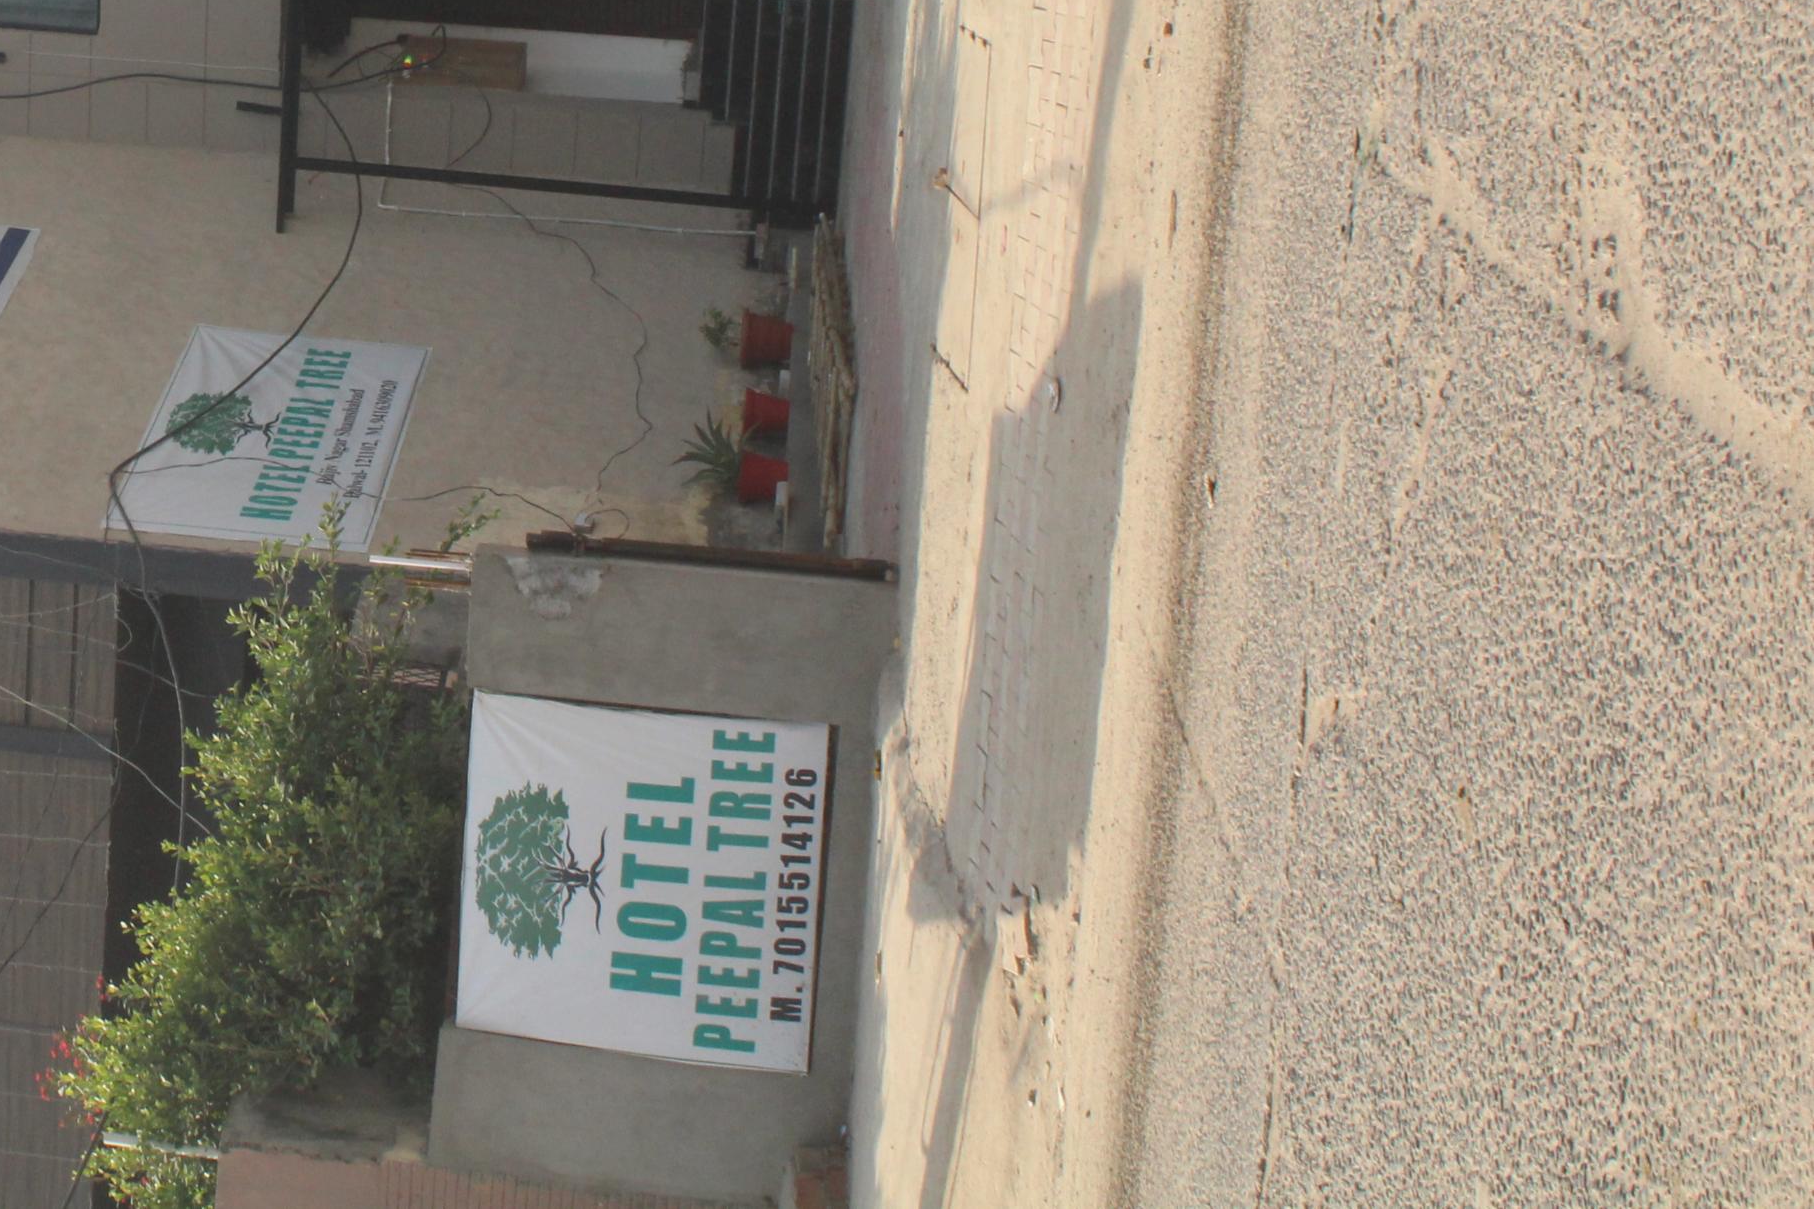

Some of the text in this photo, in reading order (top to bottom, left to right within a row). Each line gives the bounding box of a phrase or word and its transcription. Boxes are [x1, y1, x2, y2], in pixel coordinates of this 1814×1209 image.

[239, 348, 351, 521] HOTEL PEEPAL TREE
[609, 776, 695, 997] HOTEL
[692, 729, 775, 1053] PEEPAL TREE
[769, 768, 817, 1023] M. 7015514126
